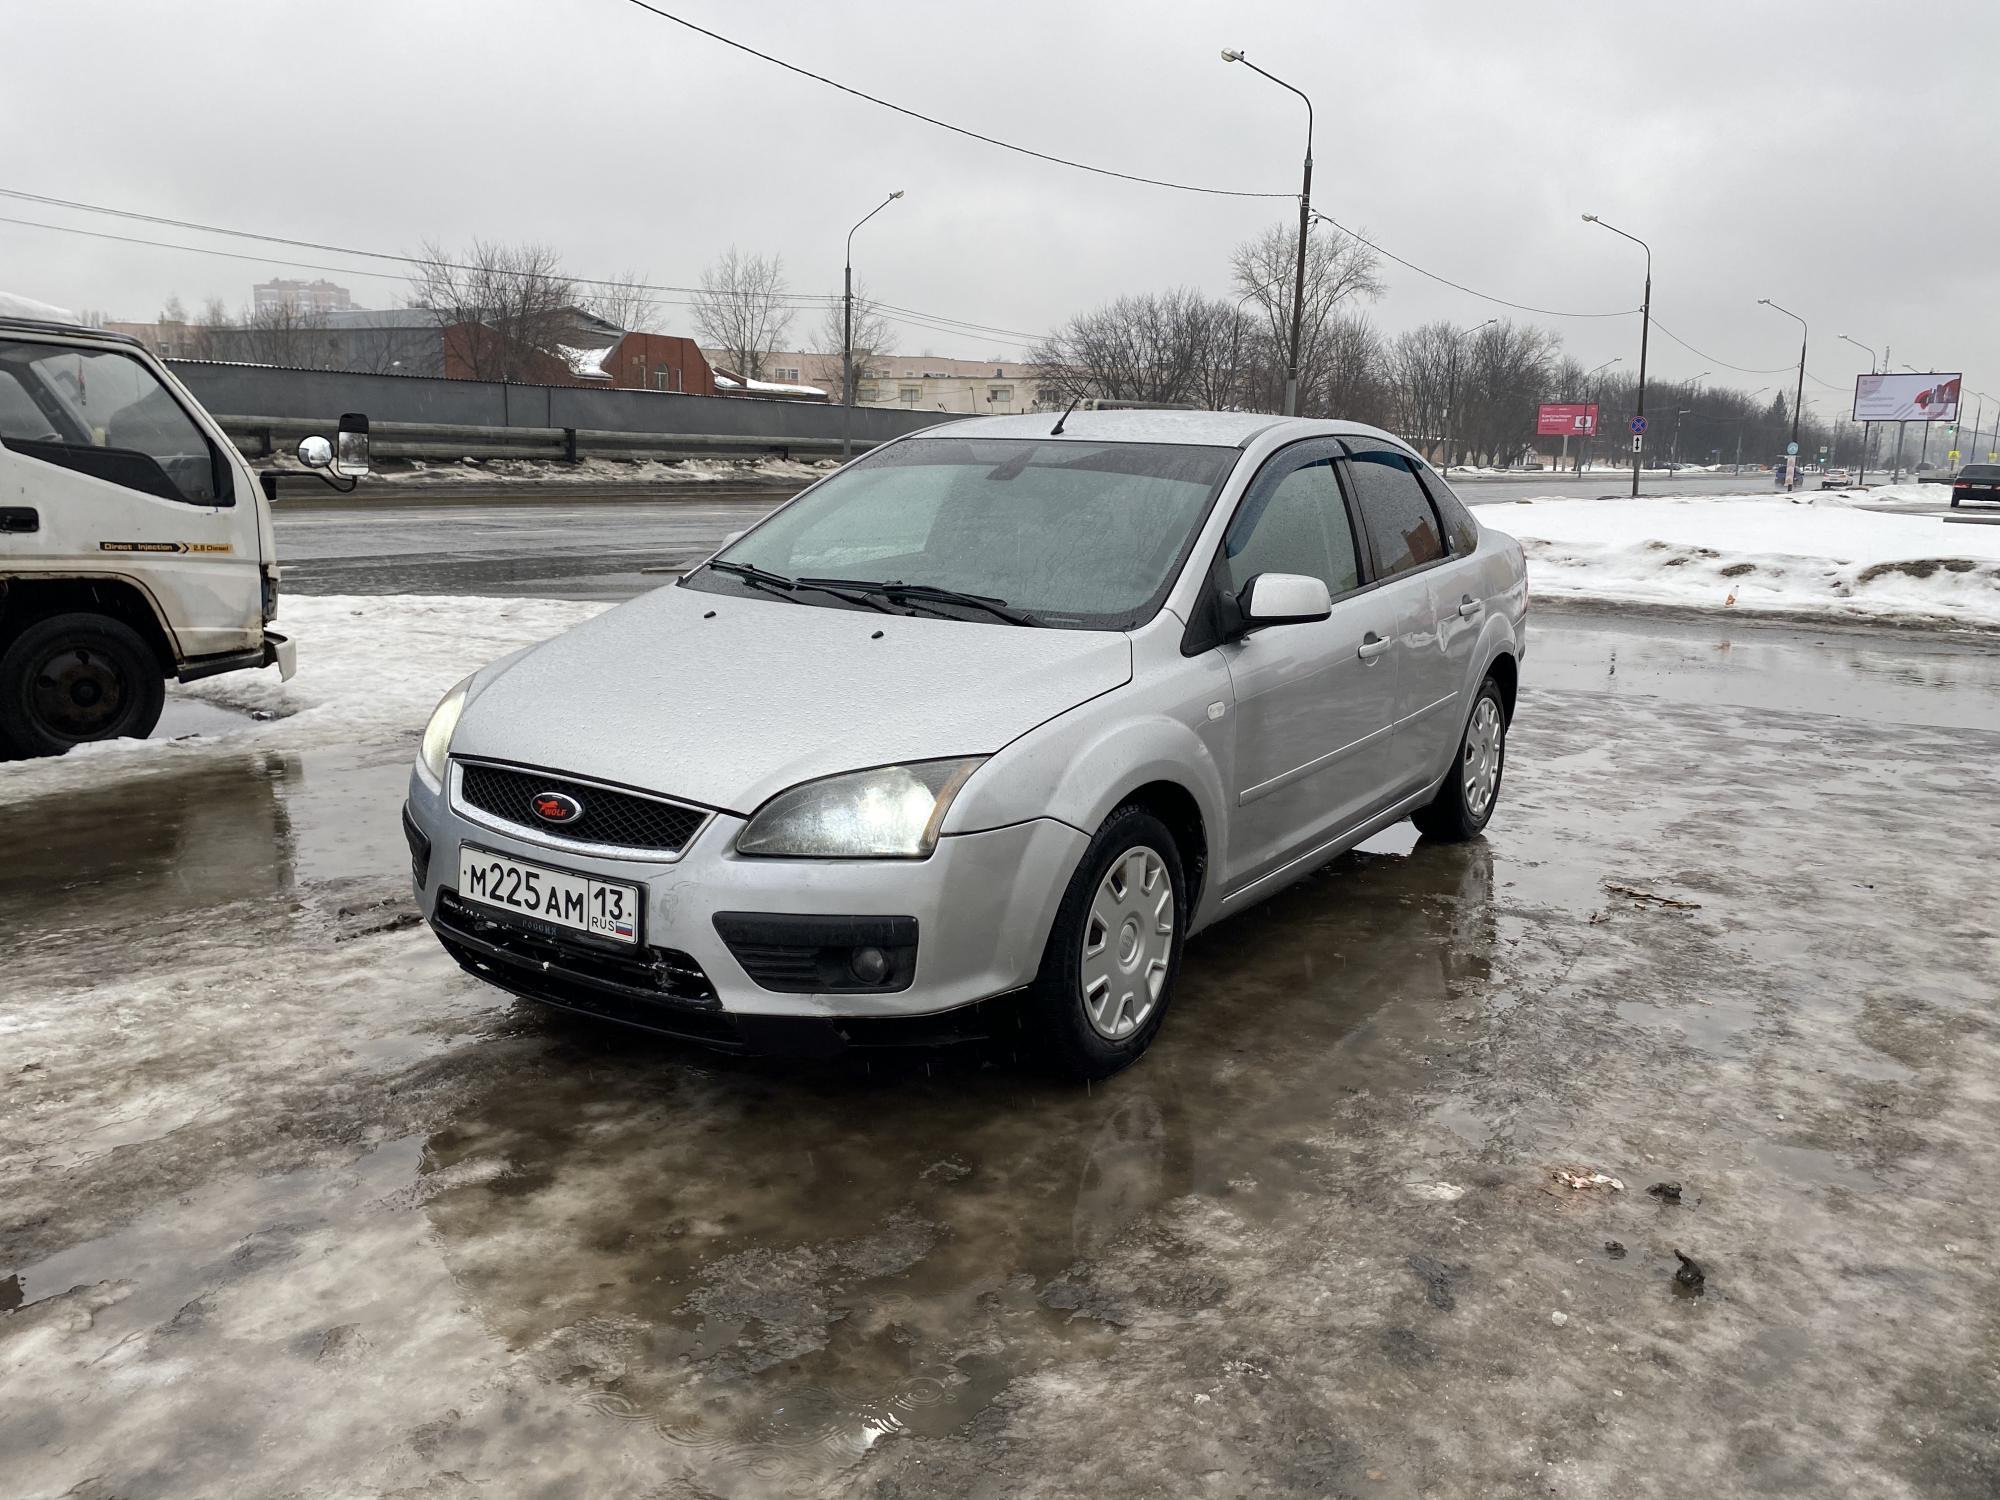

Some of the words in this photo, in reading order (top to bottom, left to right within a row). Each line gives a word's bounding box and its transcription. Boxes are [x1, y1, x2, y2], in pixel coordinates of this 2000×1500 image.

[138, 543, 173, 552] Injection
[544, 808, 567, 816] WOLF
[592, 917, 614, 931] RUS
